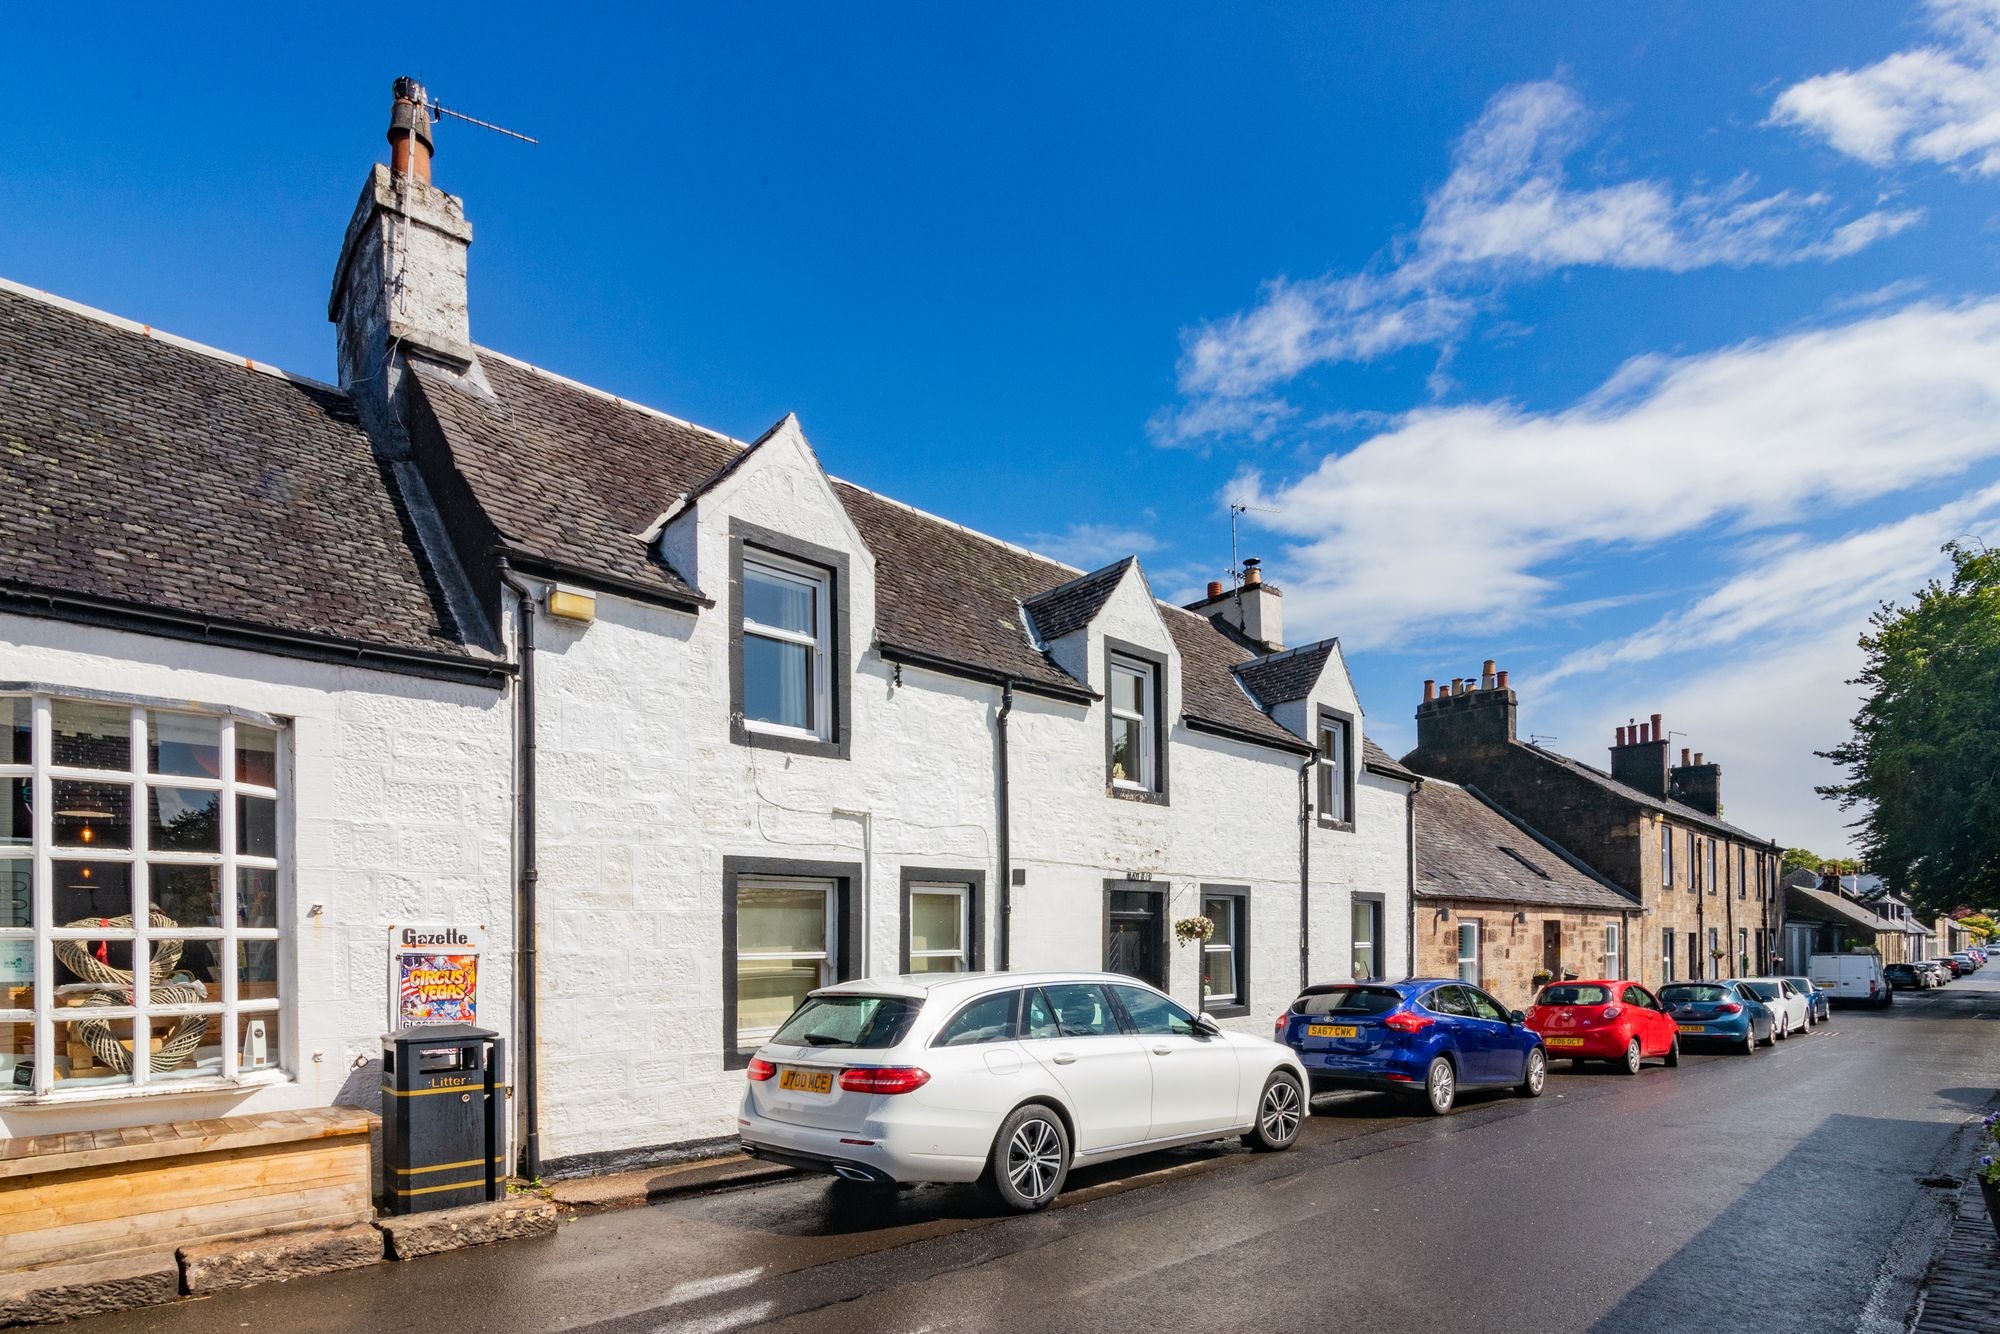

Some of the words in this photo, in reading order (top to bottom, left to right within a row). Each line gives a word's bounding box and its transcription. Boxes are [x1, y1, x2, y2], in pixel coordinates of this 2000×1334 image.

[402, 928, 468, 948] Gazette
[409, 969, 465, 986] CIRCUS
[418, 984, 466, 1003] VEGAS
[1311, 1026, 1333, 1035] SA67
[1334, 1027, 1352, 1036] CWK
[431, 1077, 466, 1088] Litter
[783, 1071, 807, 1088] J700
